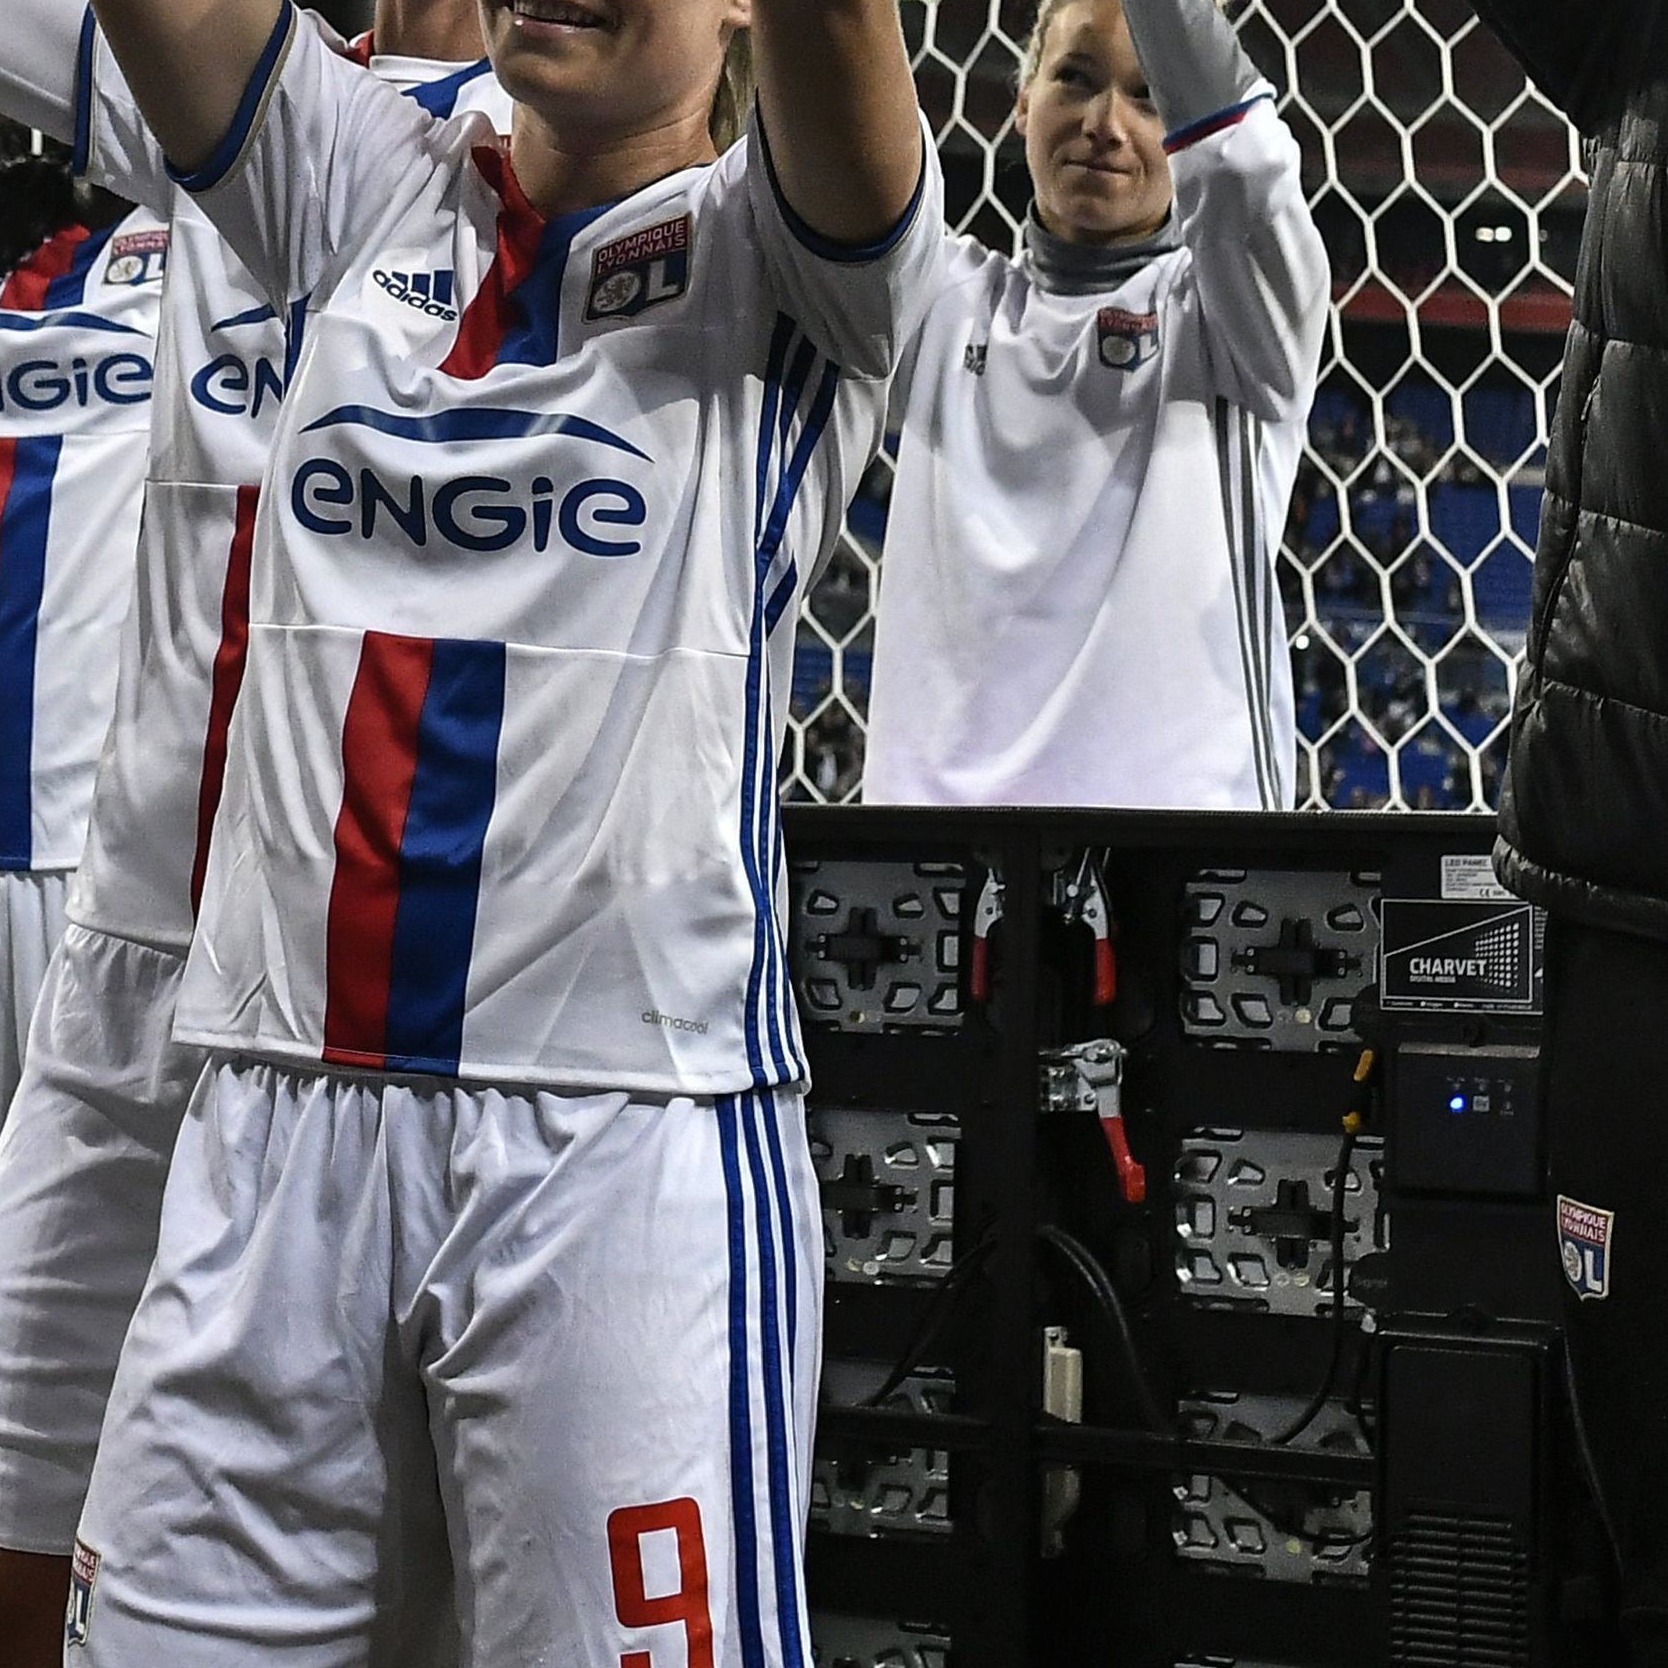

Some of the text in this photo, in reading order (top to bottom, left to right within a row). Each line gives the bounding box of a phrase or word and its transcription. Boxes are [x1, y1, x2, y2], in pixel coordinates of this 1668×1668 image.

[597, 234, 685, 274] LYONNAIS
[598, 220, 685, 262] OLYMPIQUE
[372, 269, 458, 321] adidas
[1409, 957, 1488, 977] CHARVET
[641, 1009, 709, 1035] climacool
[606, 1495, 716, 1668] 9
